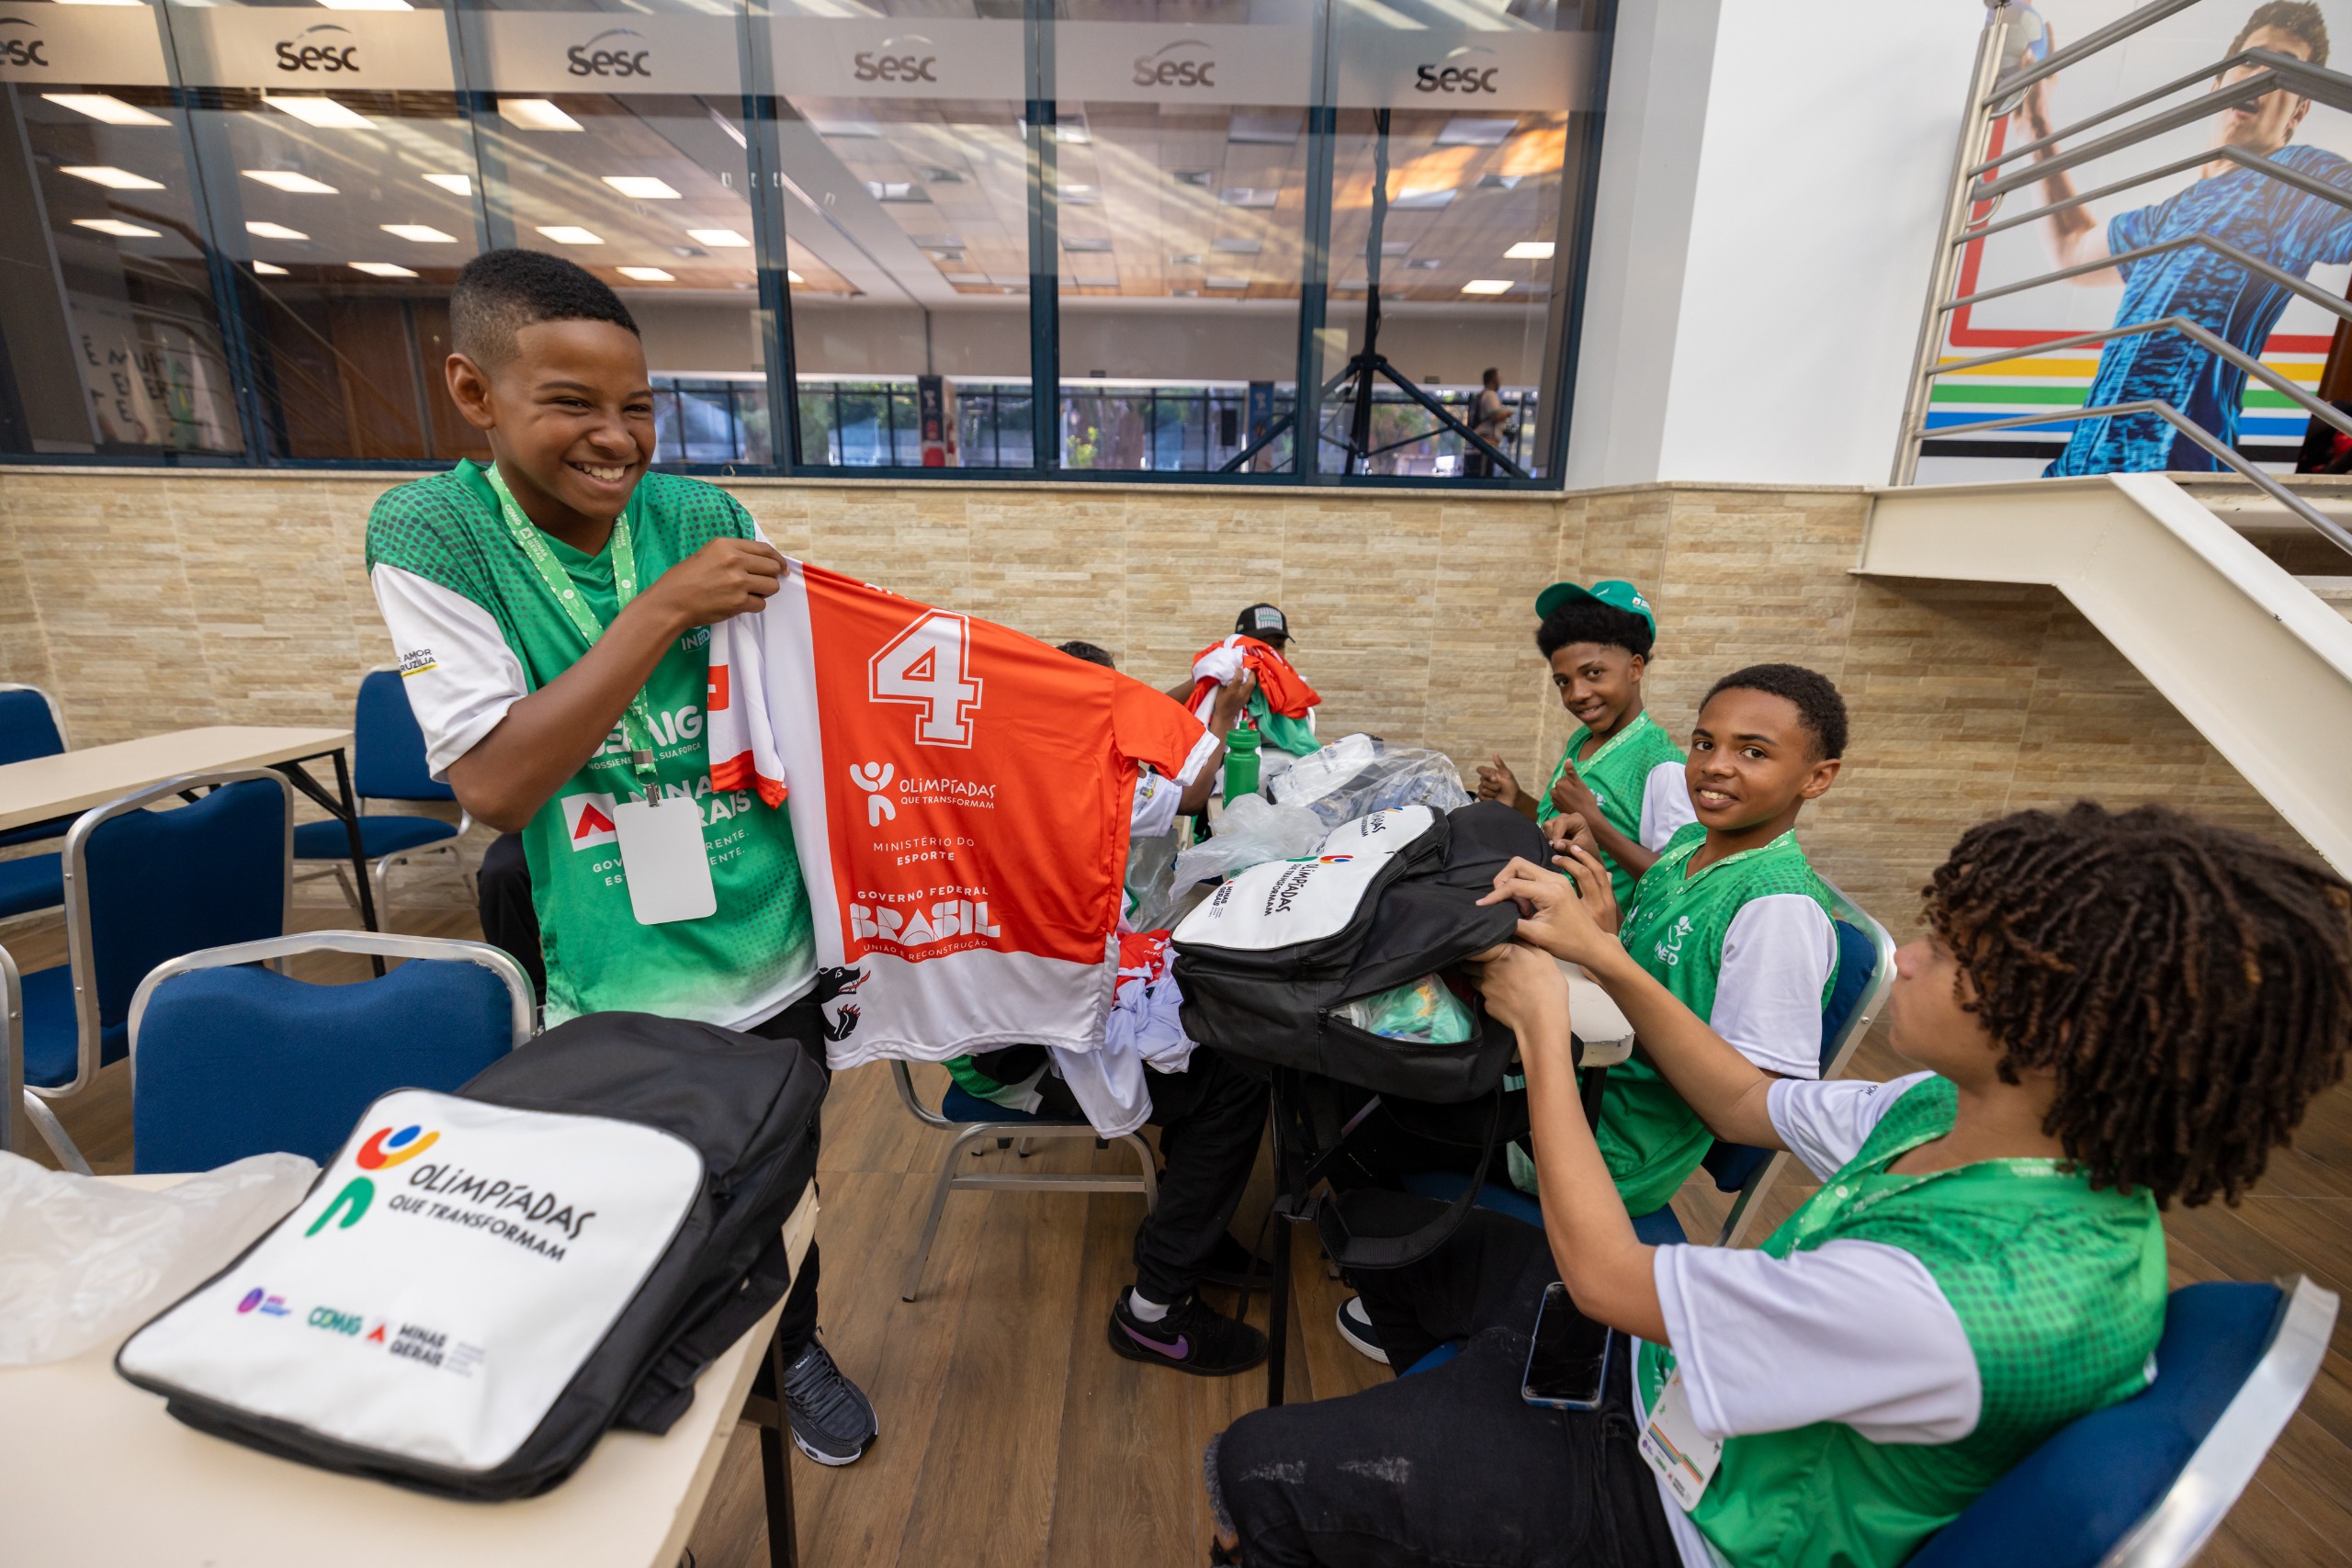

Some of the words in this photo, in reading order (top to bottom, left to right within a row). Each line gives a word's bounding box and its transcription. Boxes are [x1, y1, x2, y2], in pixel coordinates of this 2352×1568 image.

[526, 540, 545, 562] GERAIS
[531, 537, 548, 558] MINAS
[868, 608, 983, 749] 4
[660, 750, 678, 760] SUA
[900, 796, 920, 805] QUE
[922, 795, 994, 809] TRANSFORMAM
[874, 836, 952, 852] MINISTÉRIO
[957, 837, 975, 847] DO
[897, 852, 955, 865] ESPORTE
[857, 890, 923, 903] GOVERNO
[930, 885, 989, 897] FEDERAL
[850, 899, 1001, 947] BRASIL
[864, 943, 897, 953] UNIÃO
[909, 938, 988, 961] RECONSTRUÇÃO
[389, 1194, 427, 1214] QUE
[426, 1201, 566, 1263] TRANSFORMAM
